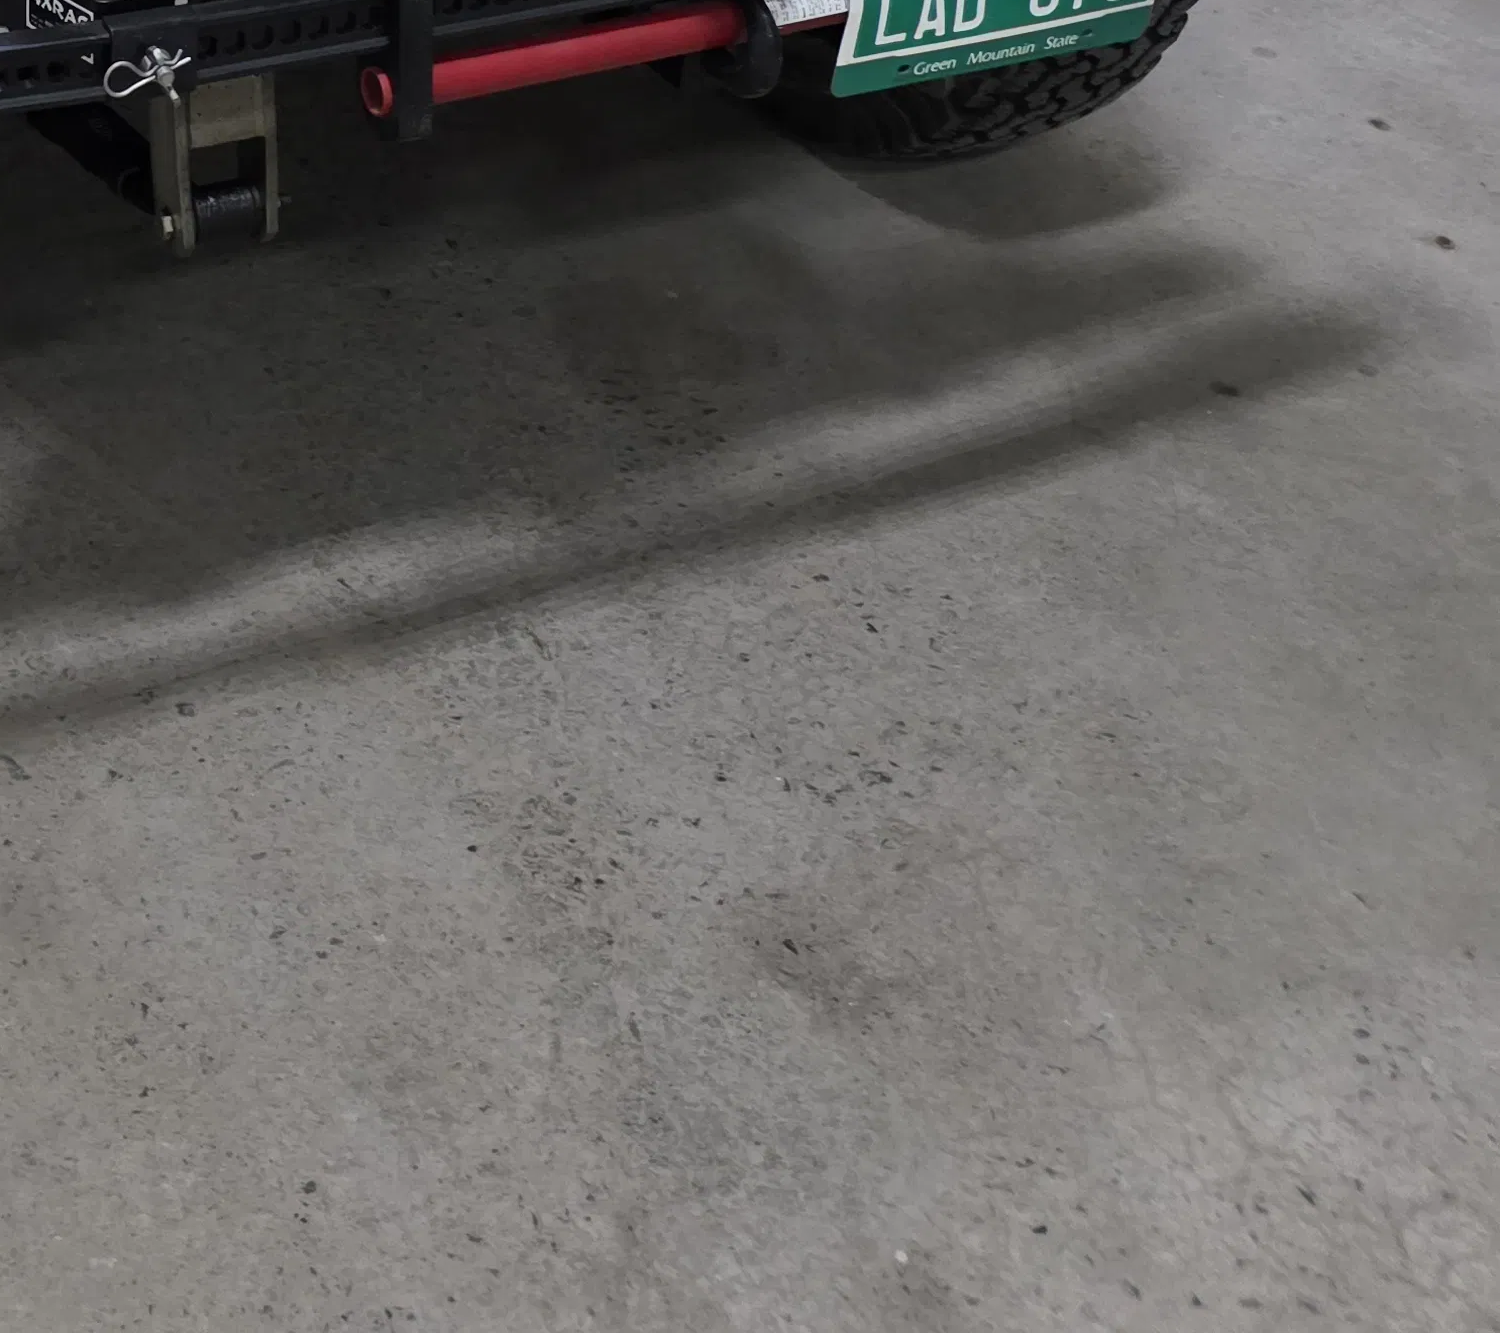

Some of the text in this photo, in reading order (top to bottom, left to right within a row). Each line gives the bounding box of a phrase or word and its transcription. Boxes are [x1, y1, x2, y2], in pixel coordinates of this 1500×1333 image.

[913, 33, 1079, 76] Green Mountain State
